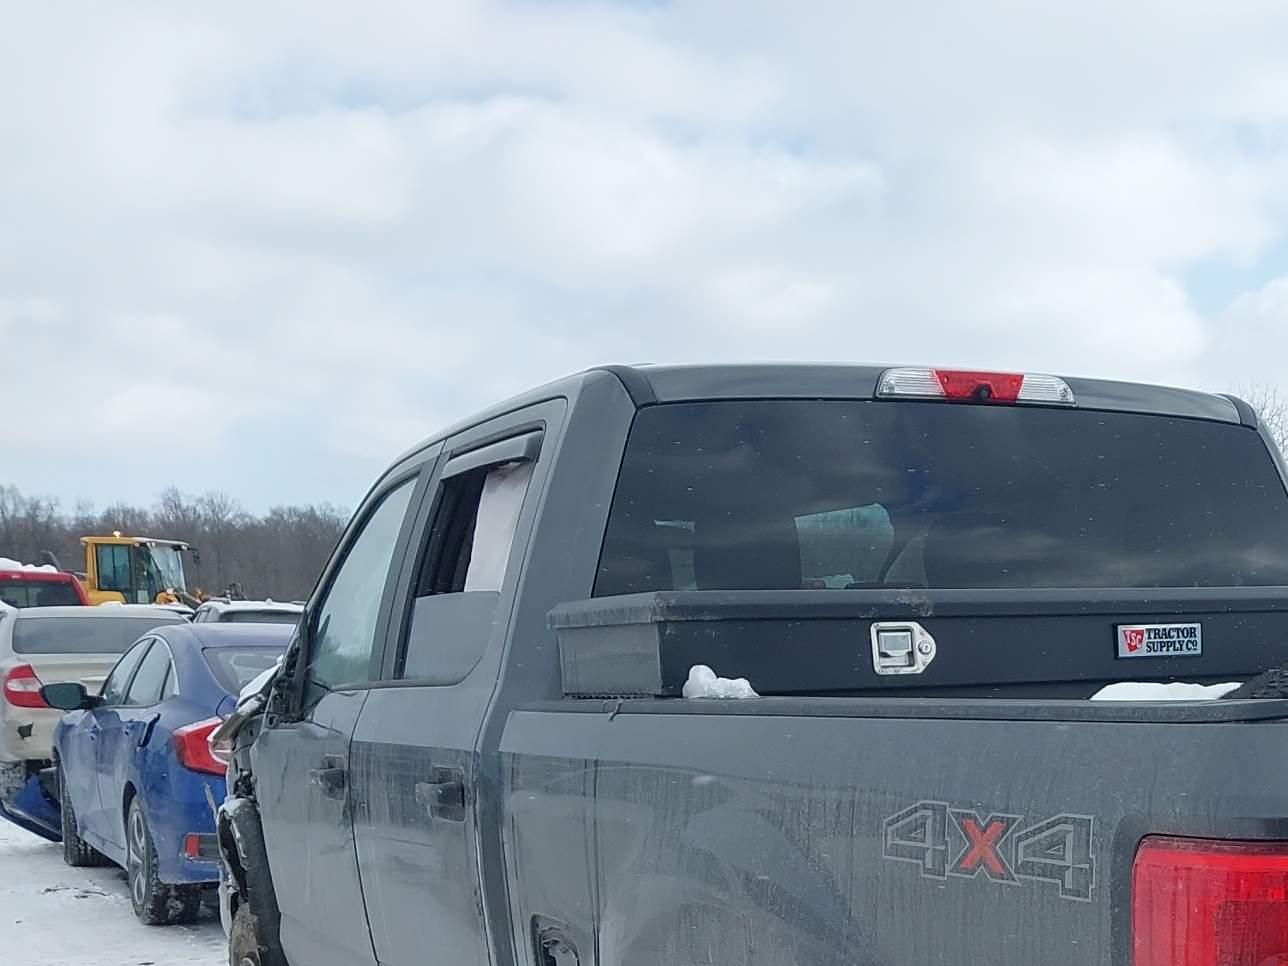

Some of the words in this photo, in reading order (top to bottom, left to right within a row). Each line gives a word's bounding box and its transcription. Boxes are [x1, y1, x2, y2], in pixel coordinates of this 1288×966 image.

[1125, 630, 1142, 649] TSC
[1145, 627, 1197, 640] TRACTOR
[1146, 640, 1184, 653] SUPPLY
